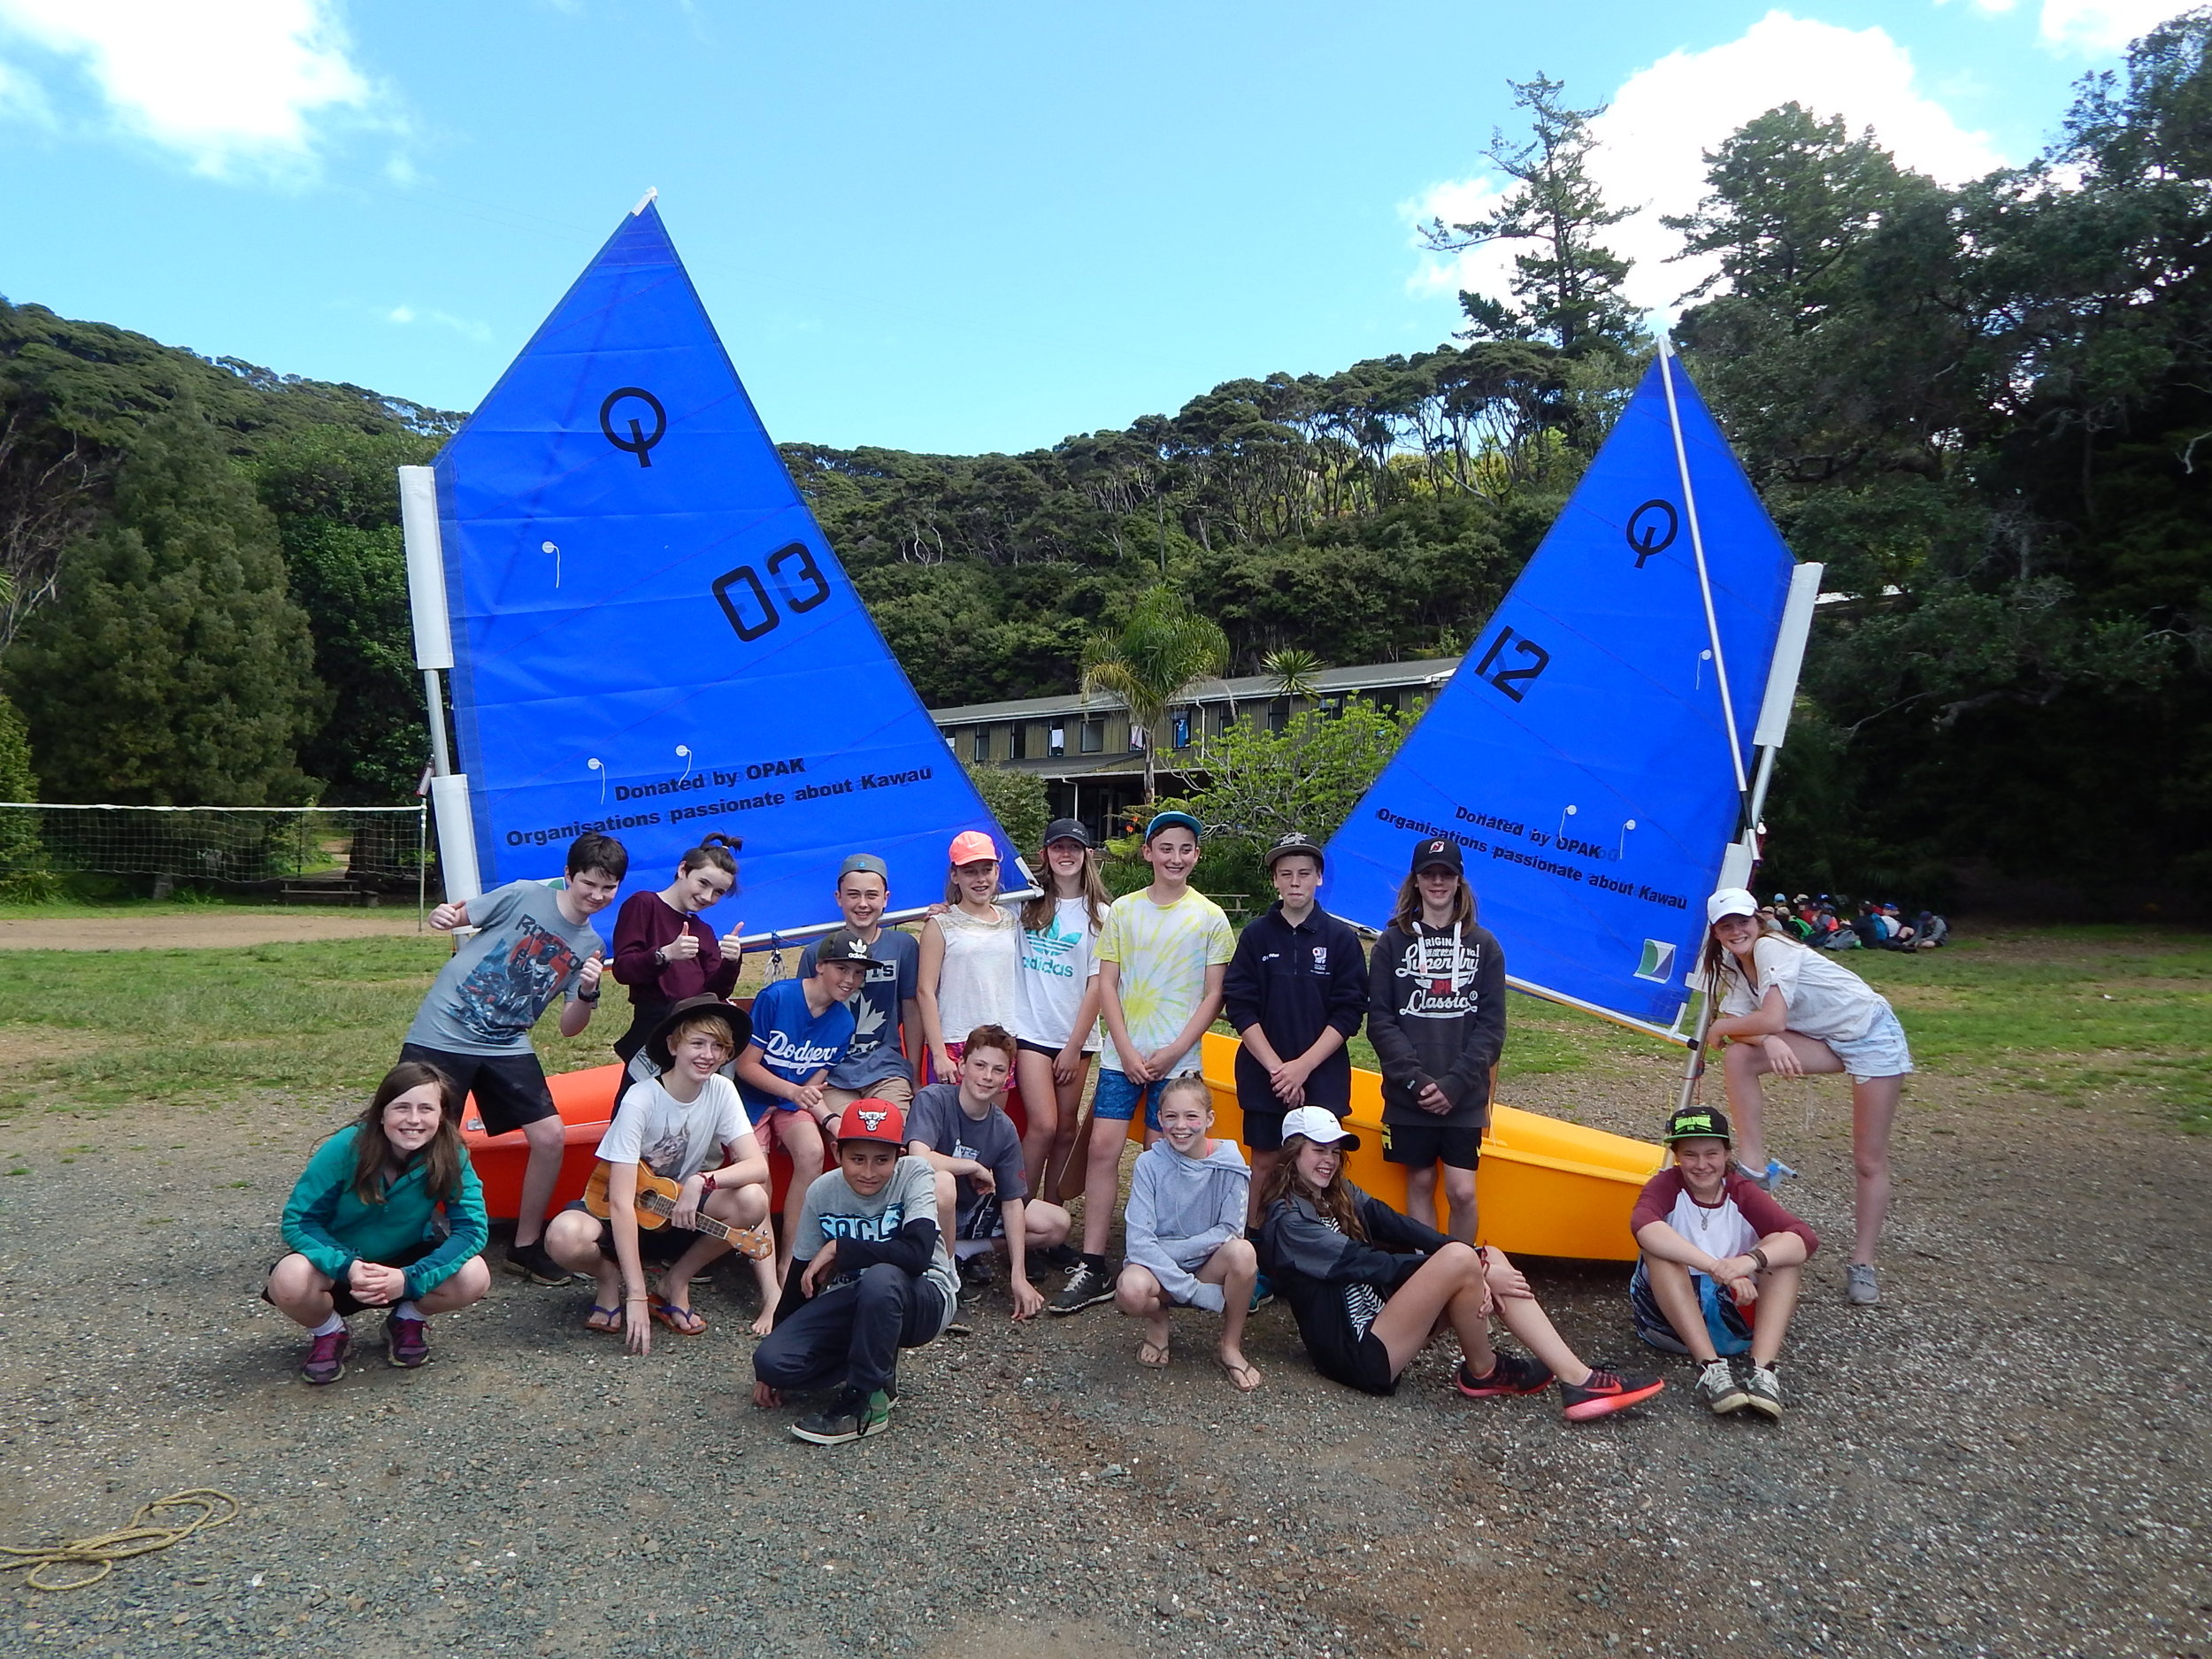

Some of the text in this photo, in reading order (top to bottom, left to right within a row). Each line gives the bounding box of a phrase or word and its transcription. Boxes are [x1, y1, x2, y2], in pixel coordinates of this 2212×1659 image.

[615, 757, 806, 802] Donated by OPAK
[506, 766, 933, 846] Organisations passionate about Kawau
[1455, 806, 1525, 836] Donated
[1530, 828, 1551, 847] by
[1377, 808, 1688, 910] Organisations passionate about Kawau
[1023, 956, 1073, 977] adidas
